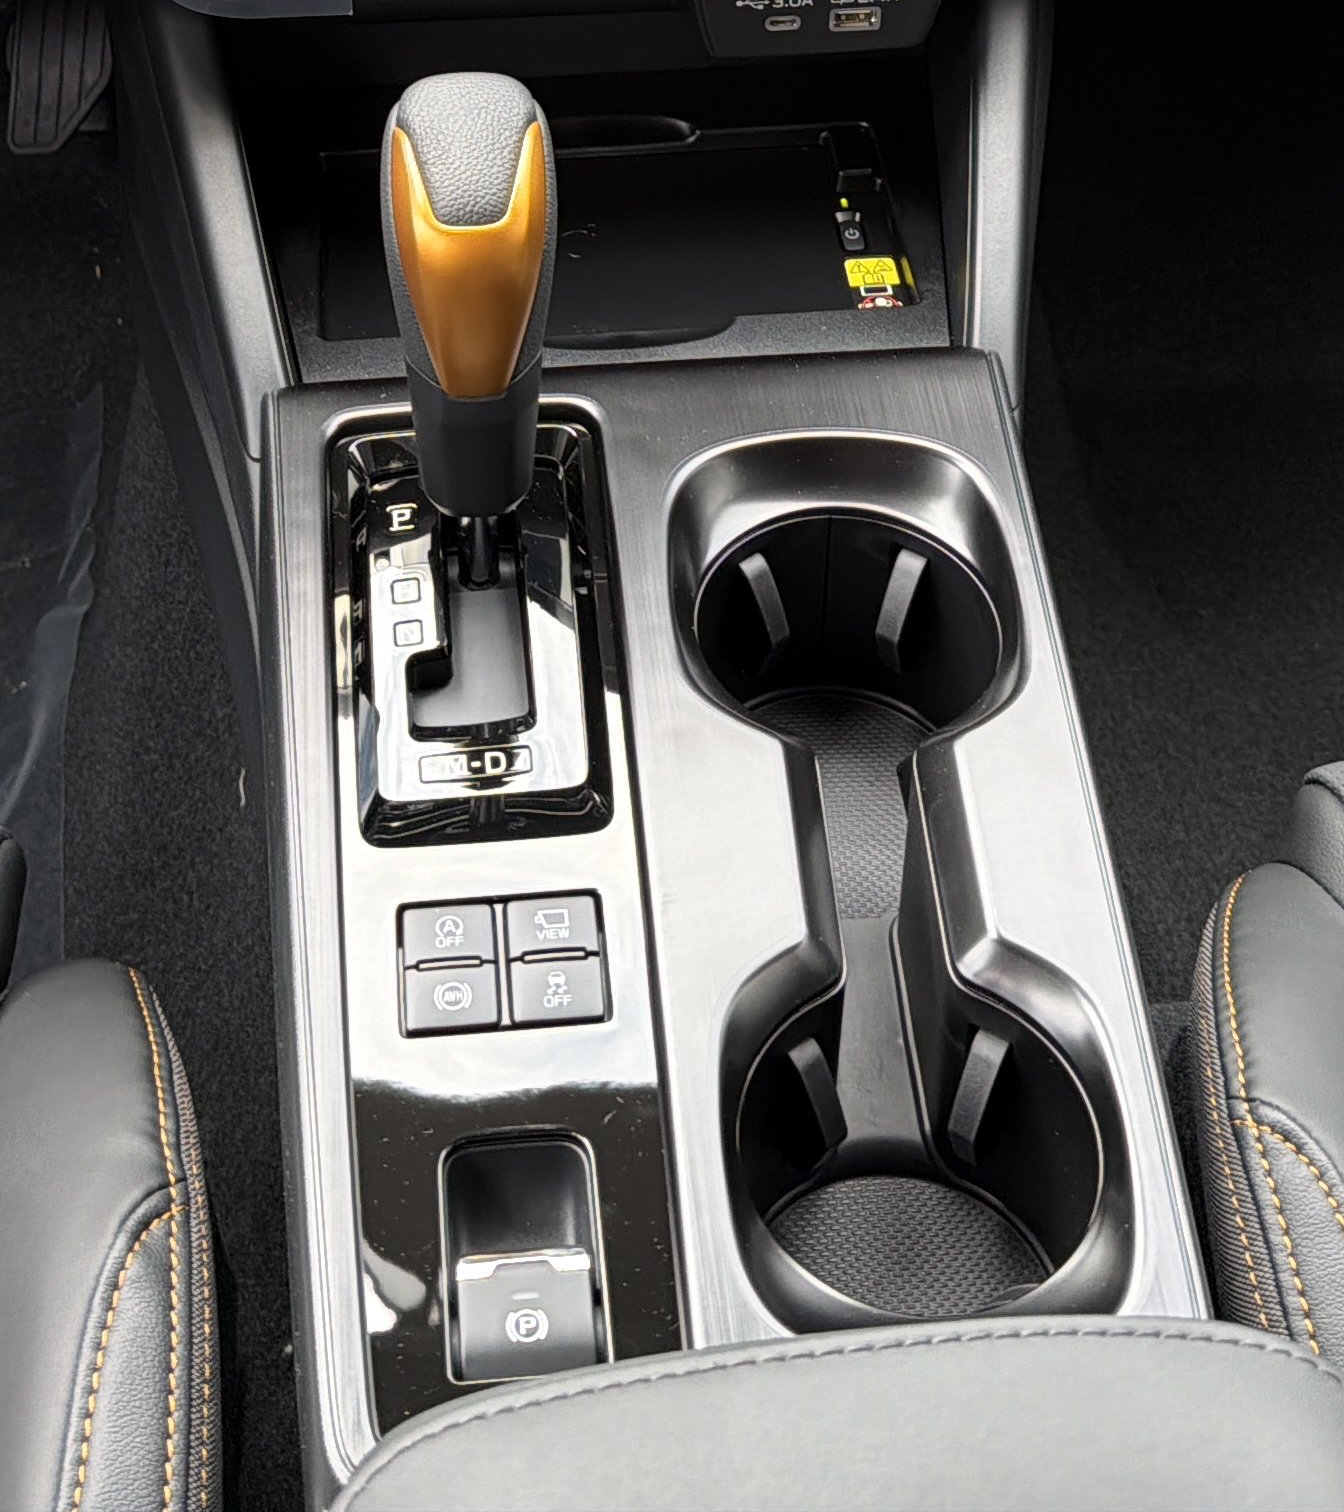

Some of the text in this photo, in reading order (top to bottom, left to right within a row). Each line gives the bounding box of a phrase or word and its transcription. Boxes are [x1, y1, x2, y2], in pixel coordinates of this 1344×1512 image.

[435, 928, 570, 948] OFF VIEW
[443, 990, 463, 1002] AVH
[543, 994, 573, 1008] OFF
[519, 1316, 536, 1335] P
